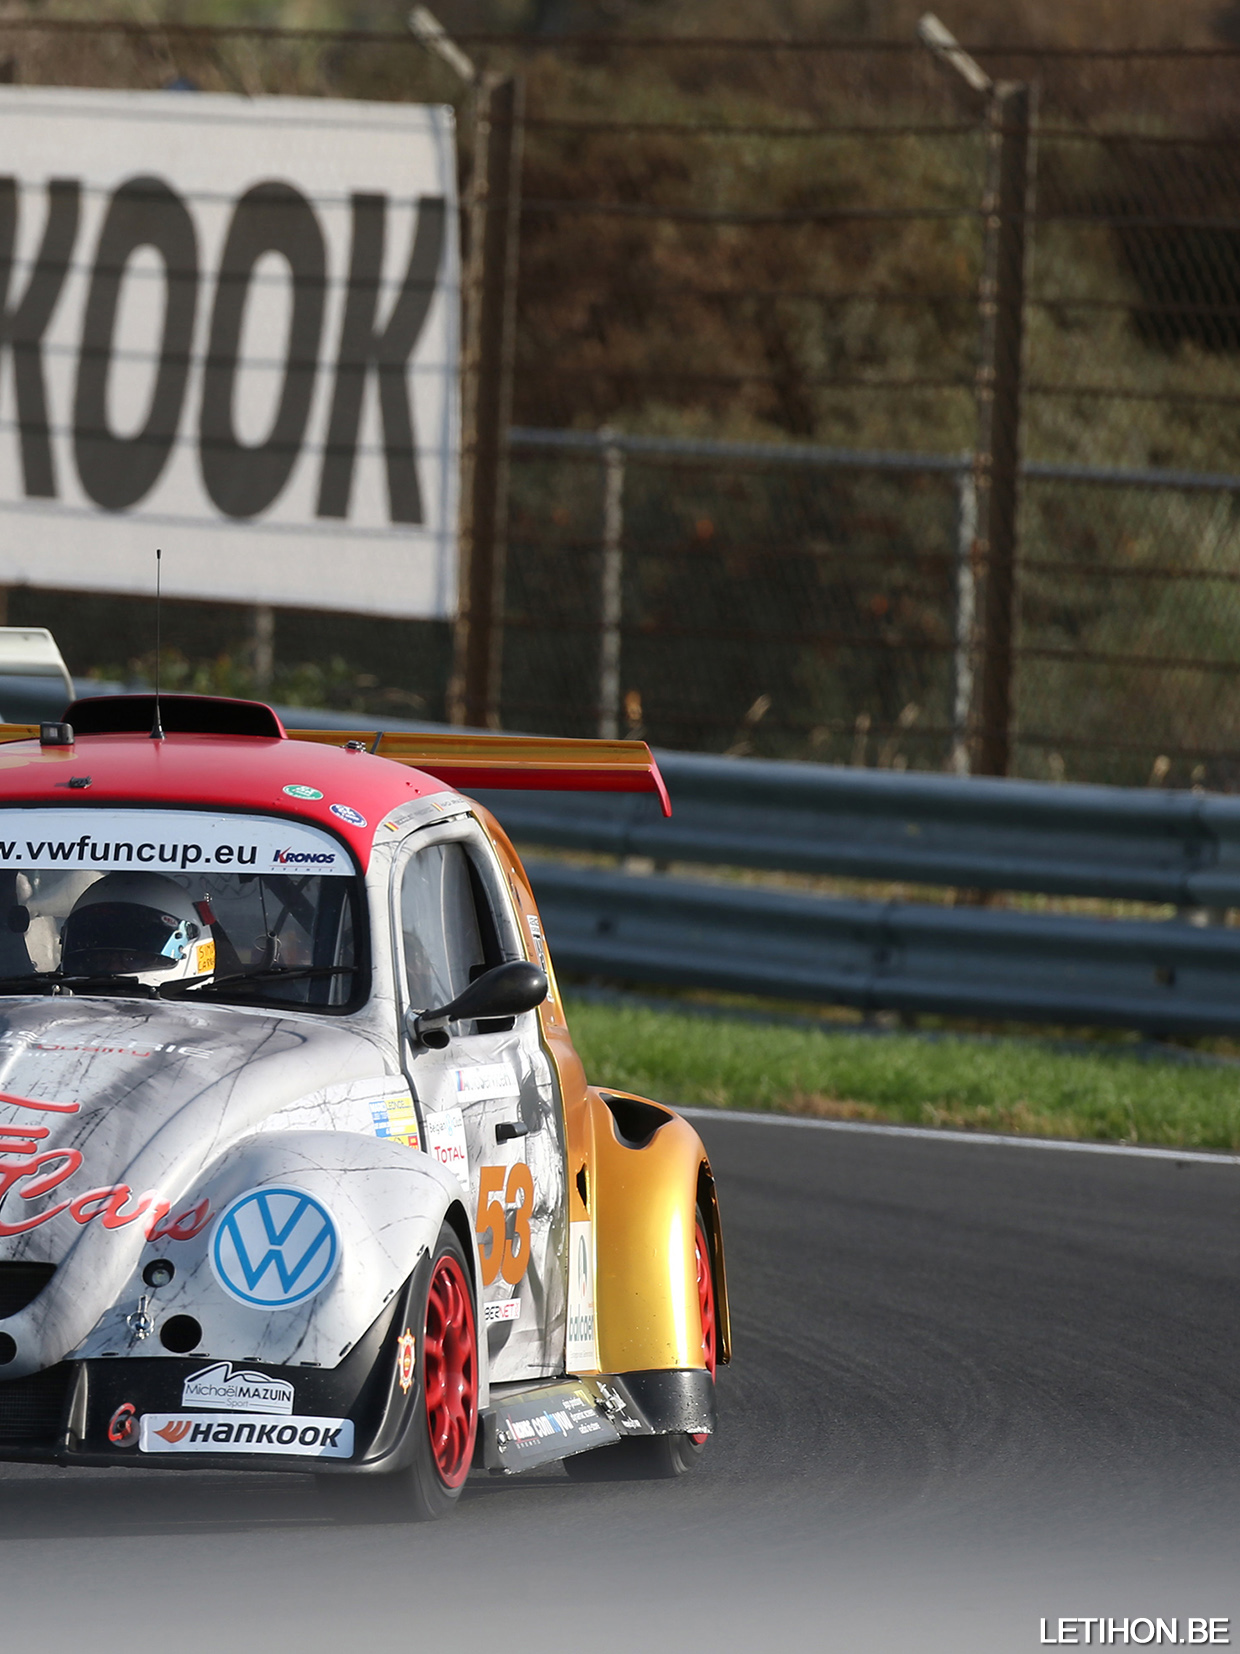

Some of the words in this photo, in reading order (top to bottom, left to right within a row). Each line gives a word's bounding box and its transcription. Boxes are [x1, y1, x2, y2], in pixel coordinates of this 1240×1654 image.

[273, 846, 336, 864] KRONOS
[434, 1145, 465, 1164] TOTAL
[476, 1162, 534, 1287] 53
[226, 1397, 249, 1408] Sport
